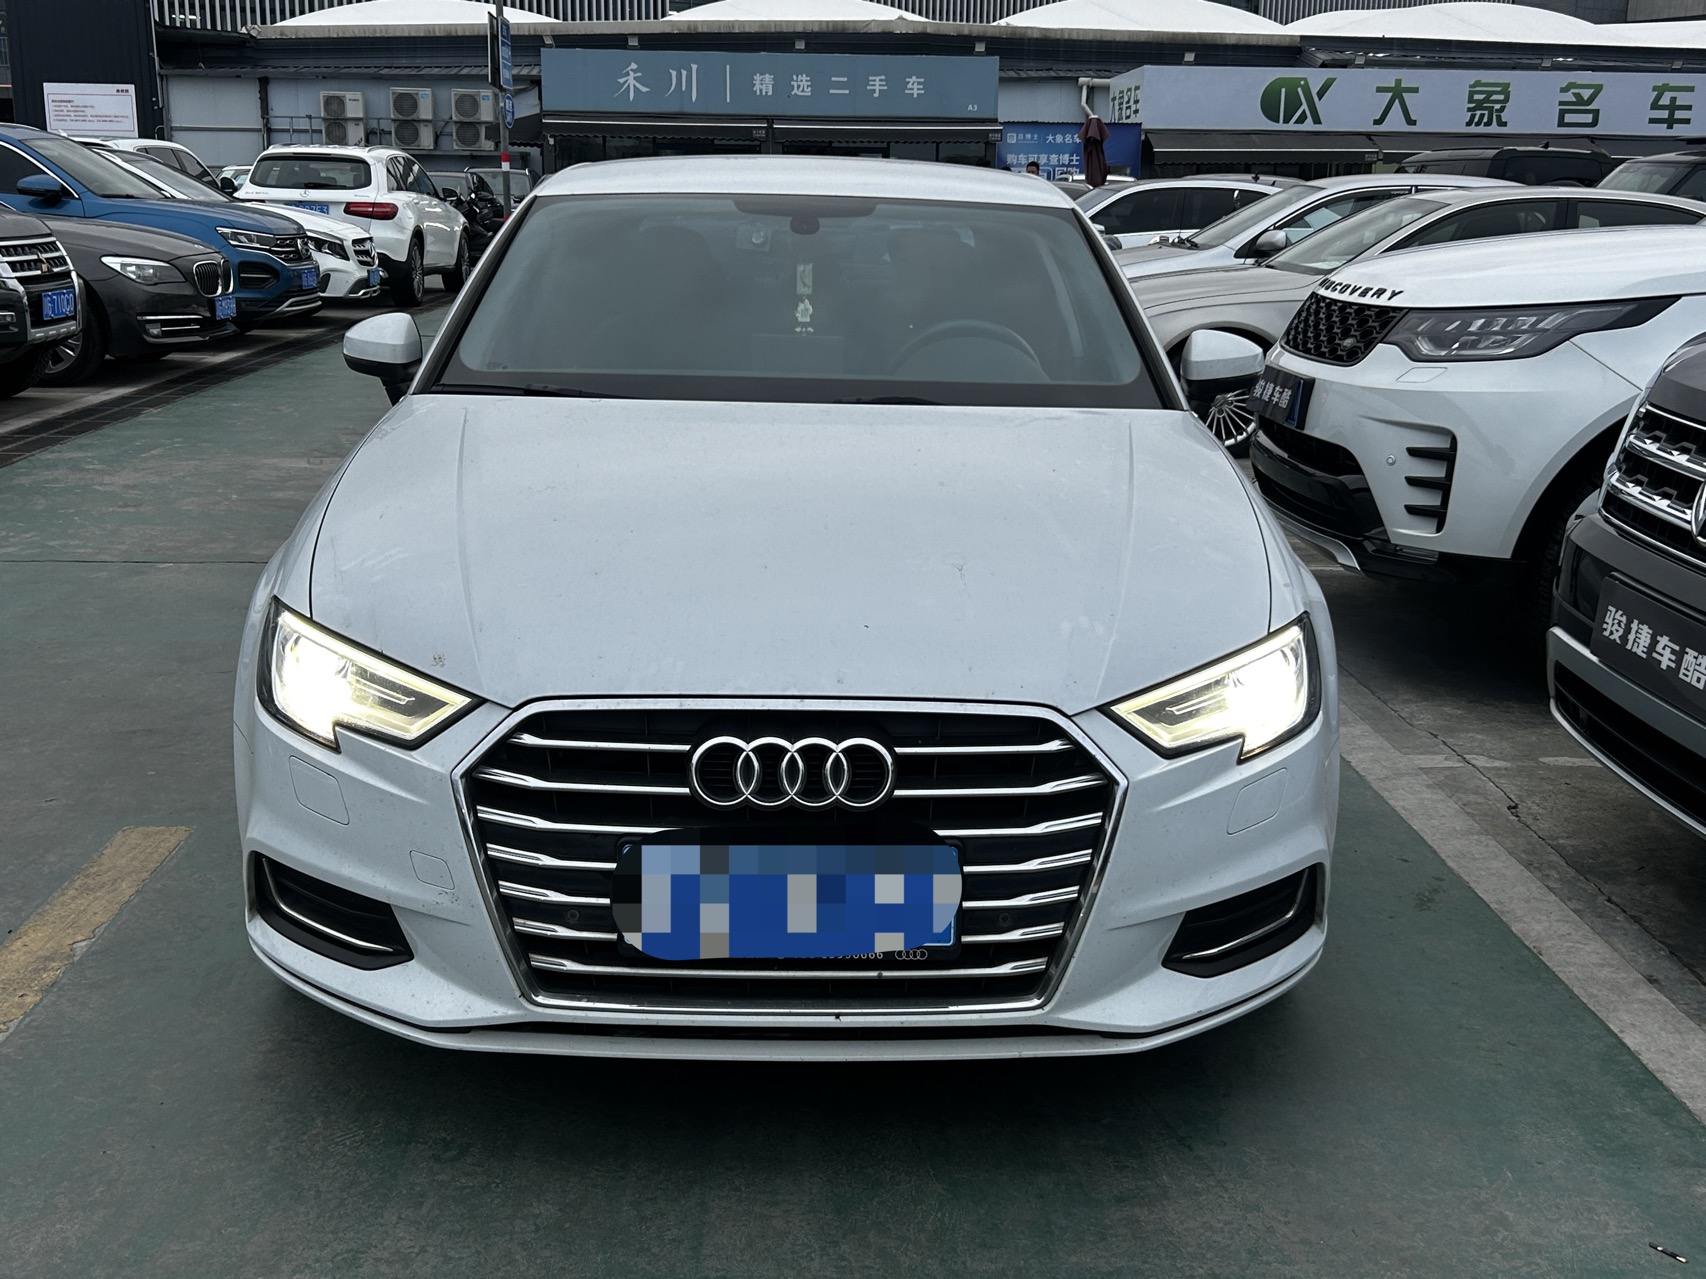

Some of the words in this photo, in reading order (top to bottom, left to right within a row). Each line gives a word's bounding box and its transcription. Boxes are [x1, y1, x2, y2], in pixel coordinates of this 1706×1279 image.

[613, 62, 698, 103] 禾川
[752, 73, 925, 98] 精选二手车
[967, 104, 978, 112] A3
[1110, 84, 1141, 122] 大象名车
[1372, 78, 1696, 130] 大象名车
[1007, 154, 1080, 165] 购车可享查博士
[1253, 379, 1292, 409] 骏捷车酷
[1601, 605, 1706, 691] 骏捷车酷
